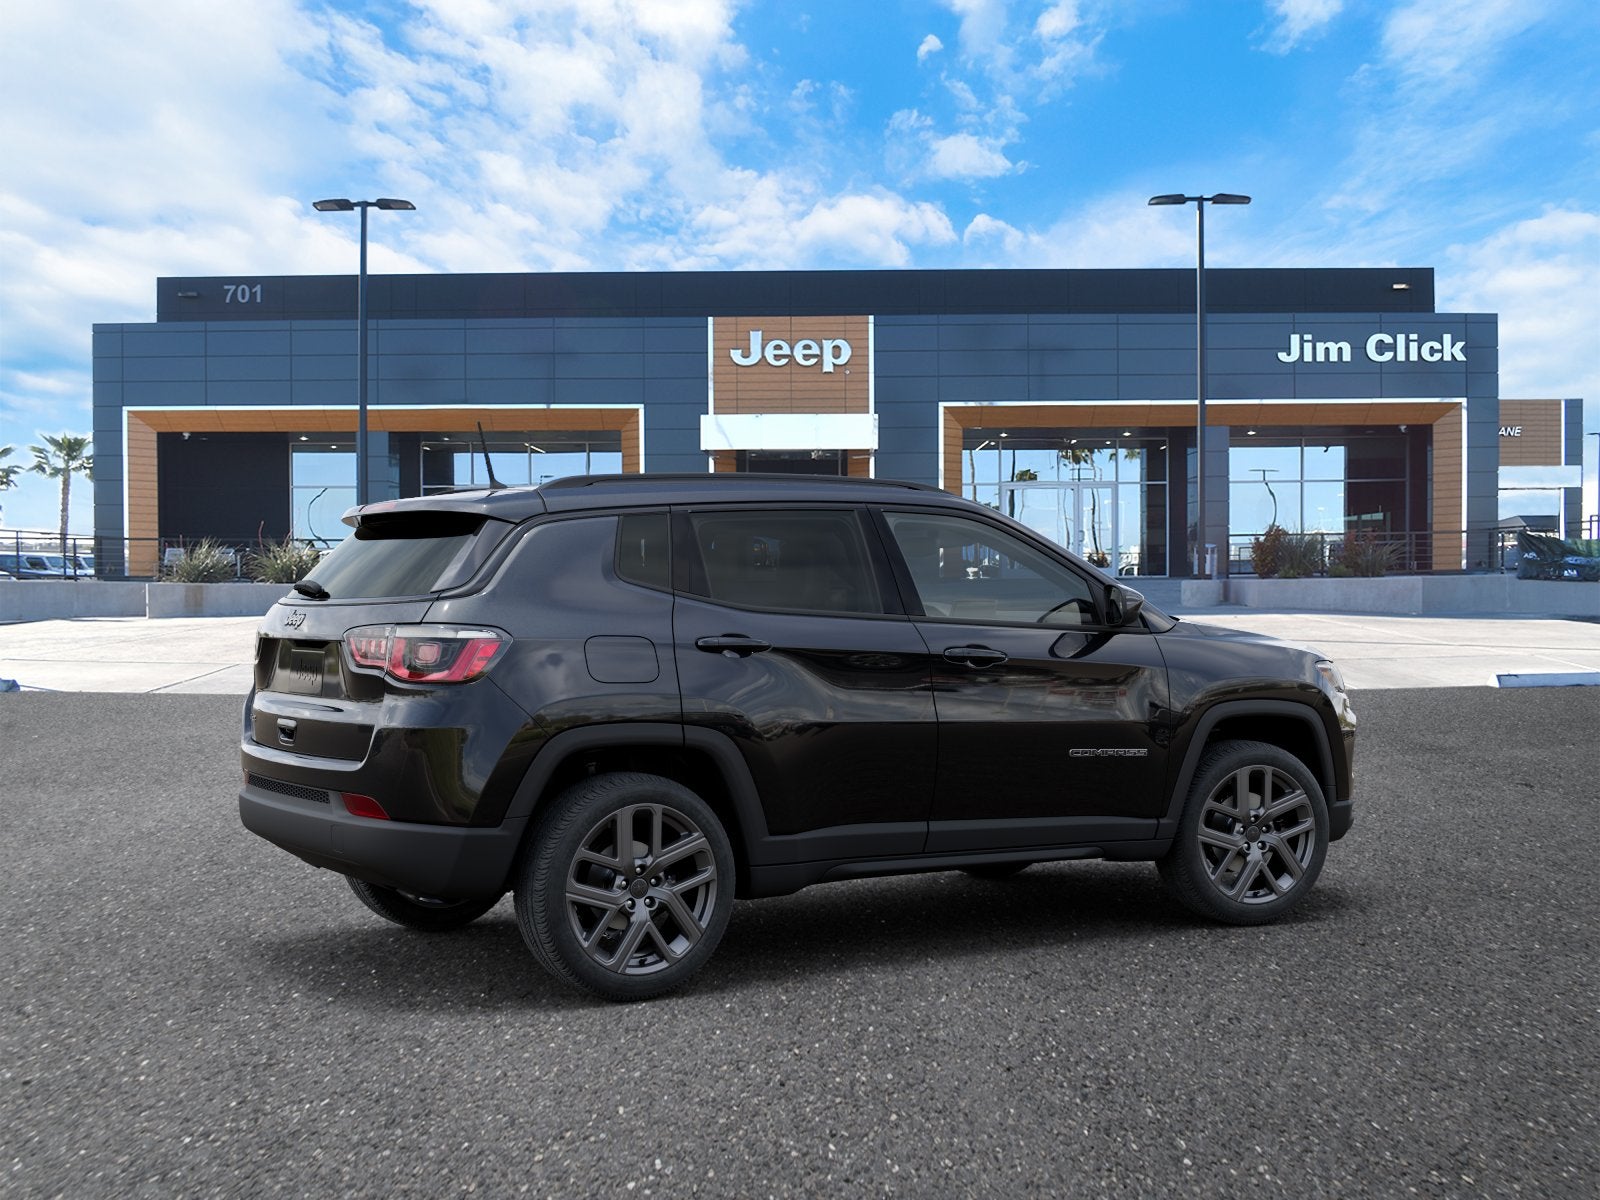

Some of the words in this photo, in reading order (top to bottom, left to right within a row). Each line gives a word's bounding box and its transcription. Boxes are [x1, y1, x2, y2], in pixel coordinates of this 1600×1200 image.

[223, 284, 262, 303] 701
[729, 330, 852, 373] Jeep
[1277, 333, 1352, 363] Jim
[1366, 333, 1467, 363] Click
[1069, 748, 1148, 757] COMPASS
